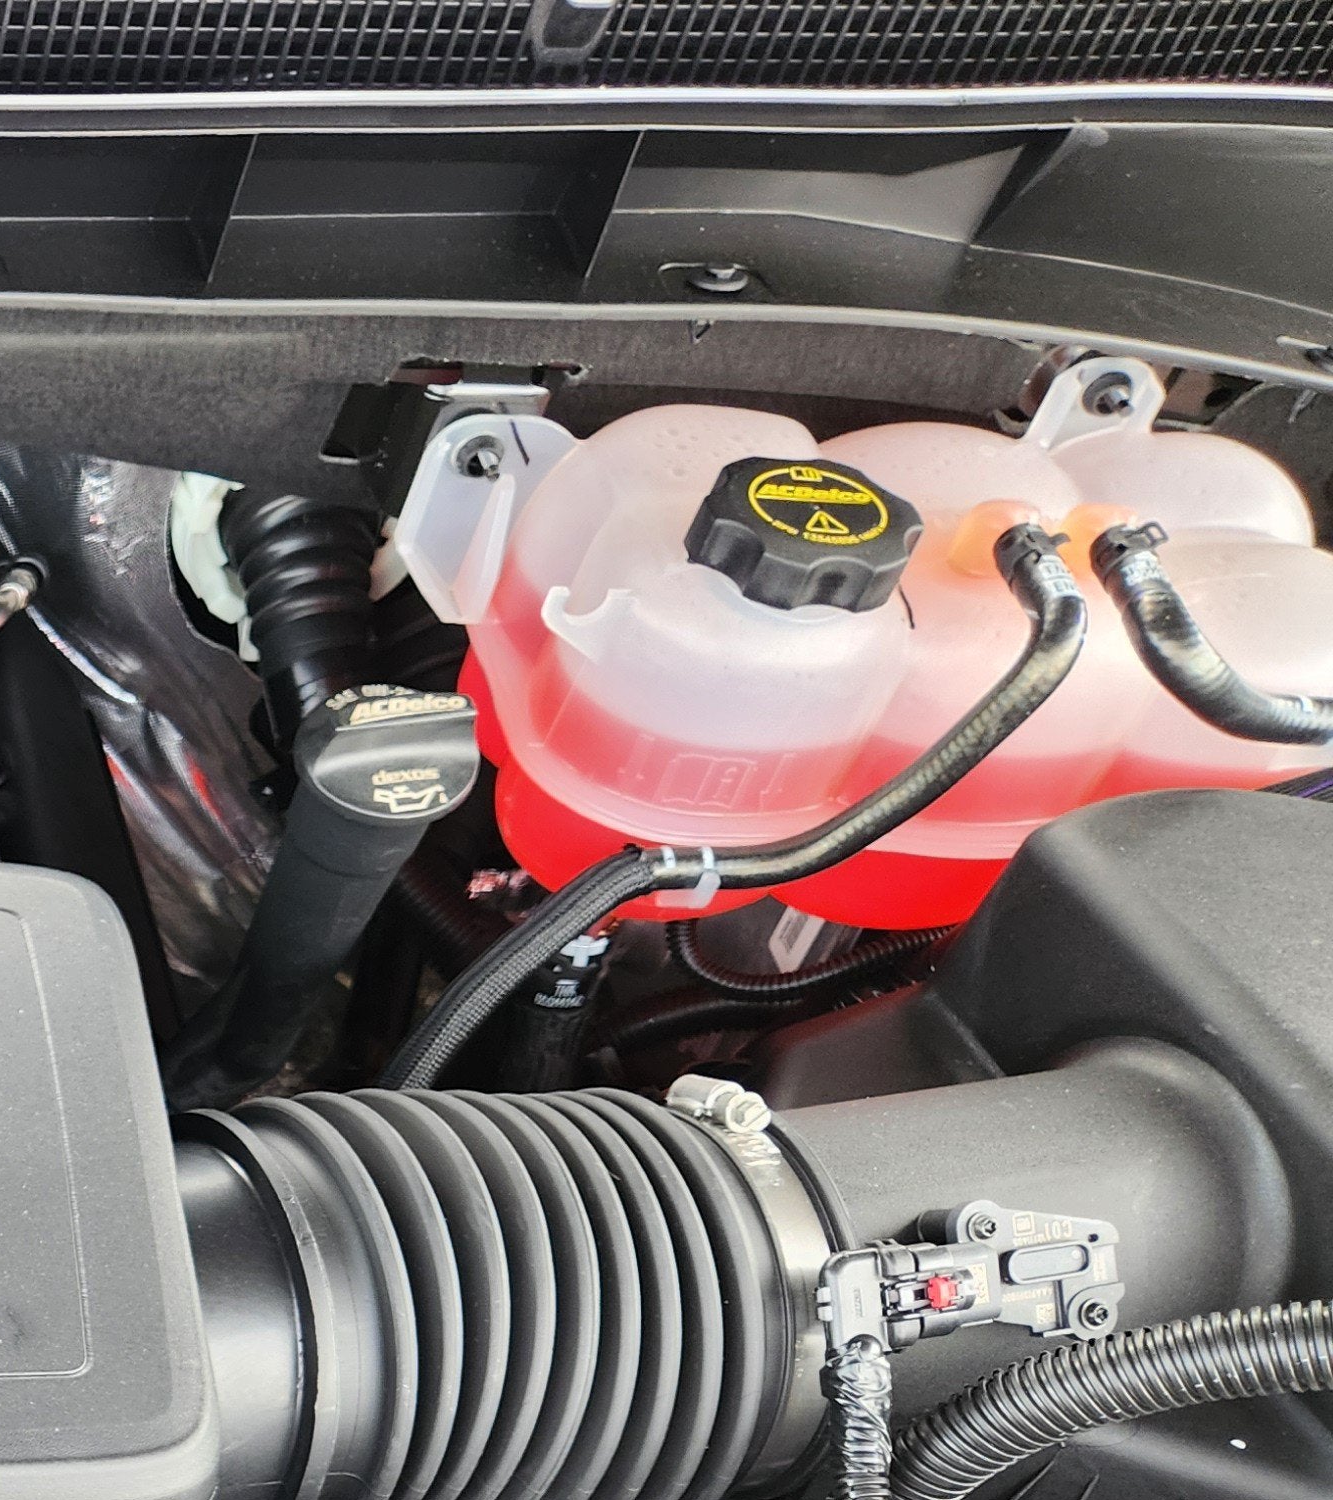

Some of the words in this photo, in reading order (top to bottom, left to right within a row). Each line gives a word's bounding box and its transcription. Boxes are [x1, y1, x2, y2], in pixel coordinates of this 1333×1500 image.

[757, 484, 872, 504] ACDelco
[350, 694, 467, 724] ACDelco
[372, 768, 440, 785] dexos
